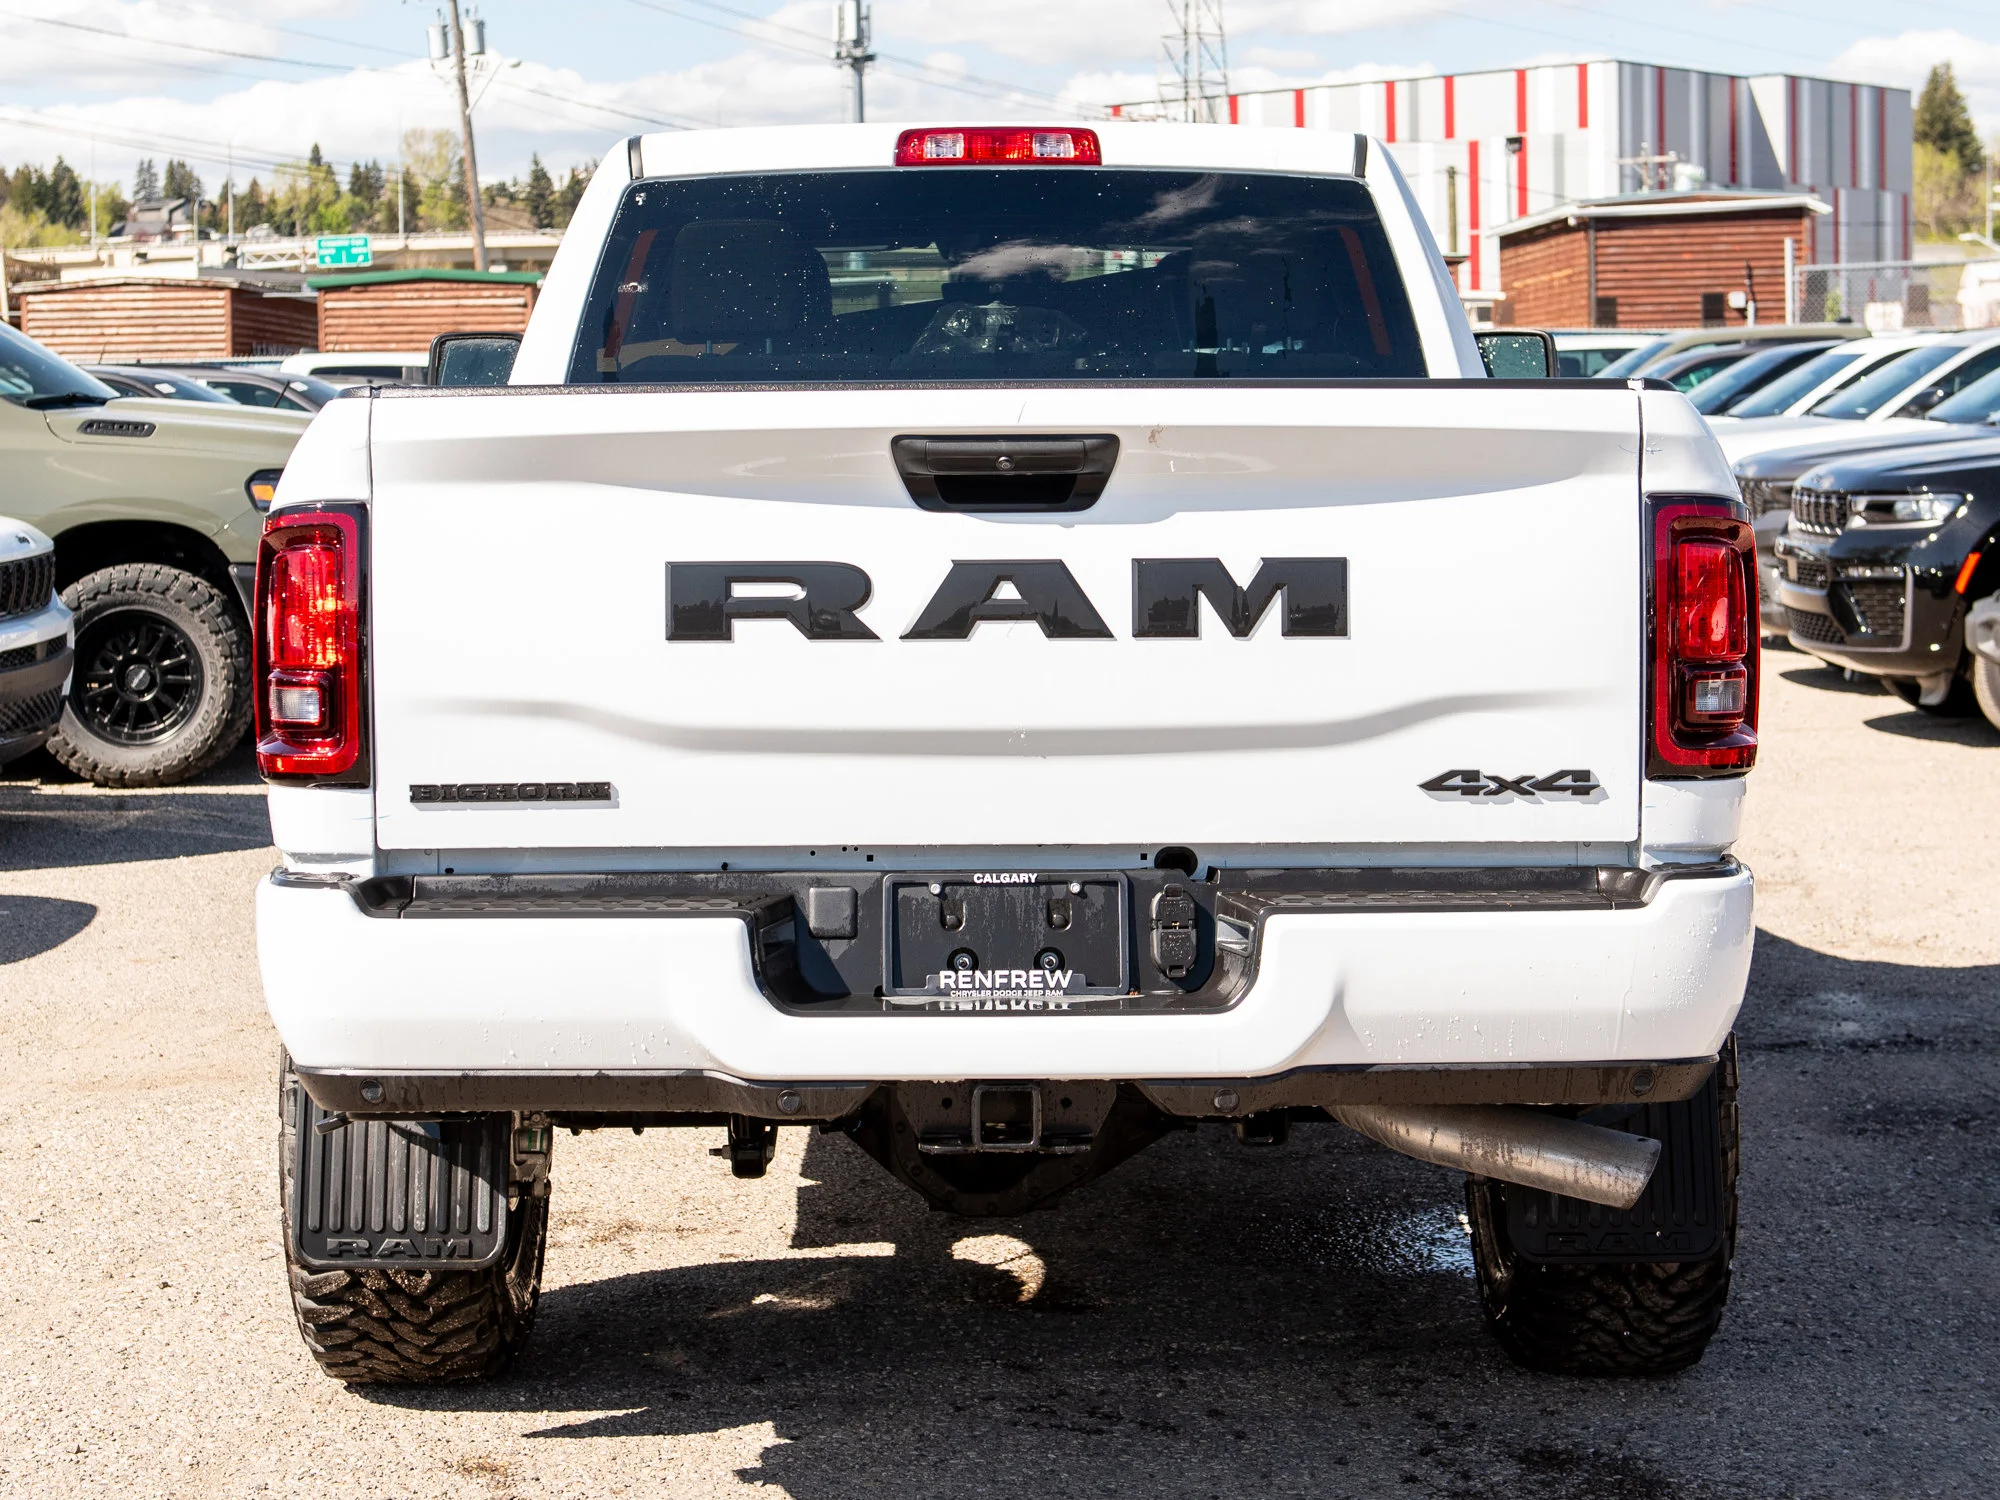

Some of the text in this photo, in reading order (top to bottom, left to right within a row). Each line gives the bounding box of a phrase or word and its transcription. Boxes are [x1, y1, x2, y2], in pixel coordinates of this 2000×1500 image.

[665, 557, 1349, 641] RAM
[409, 782, 612, 803] BIGHORN
[973, 873, 1038, 884] CALGARY
[939, 970, 1073, 989] RENFREW
[327, 1237, 473, 1257] RAM
[1545, 1231, 1691, 1250] RAM
